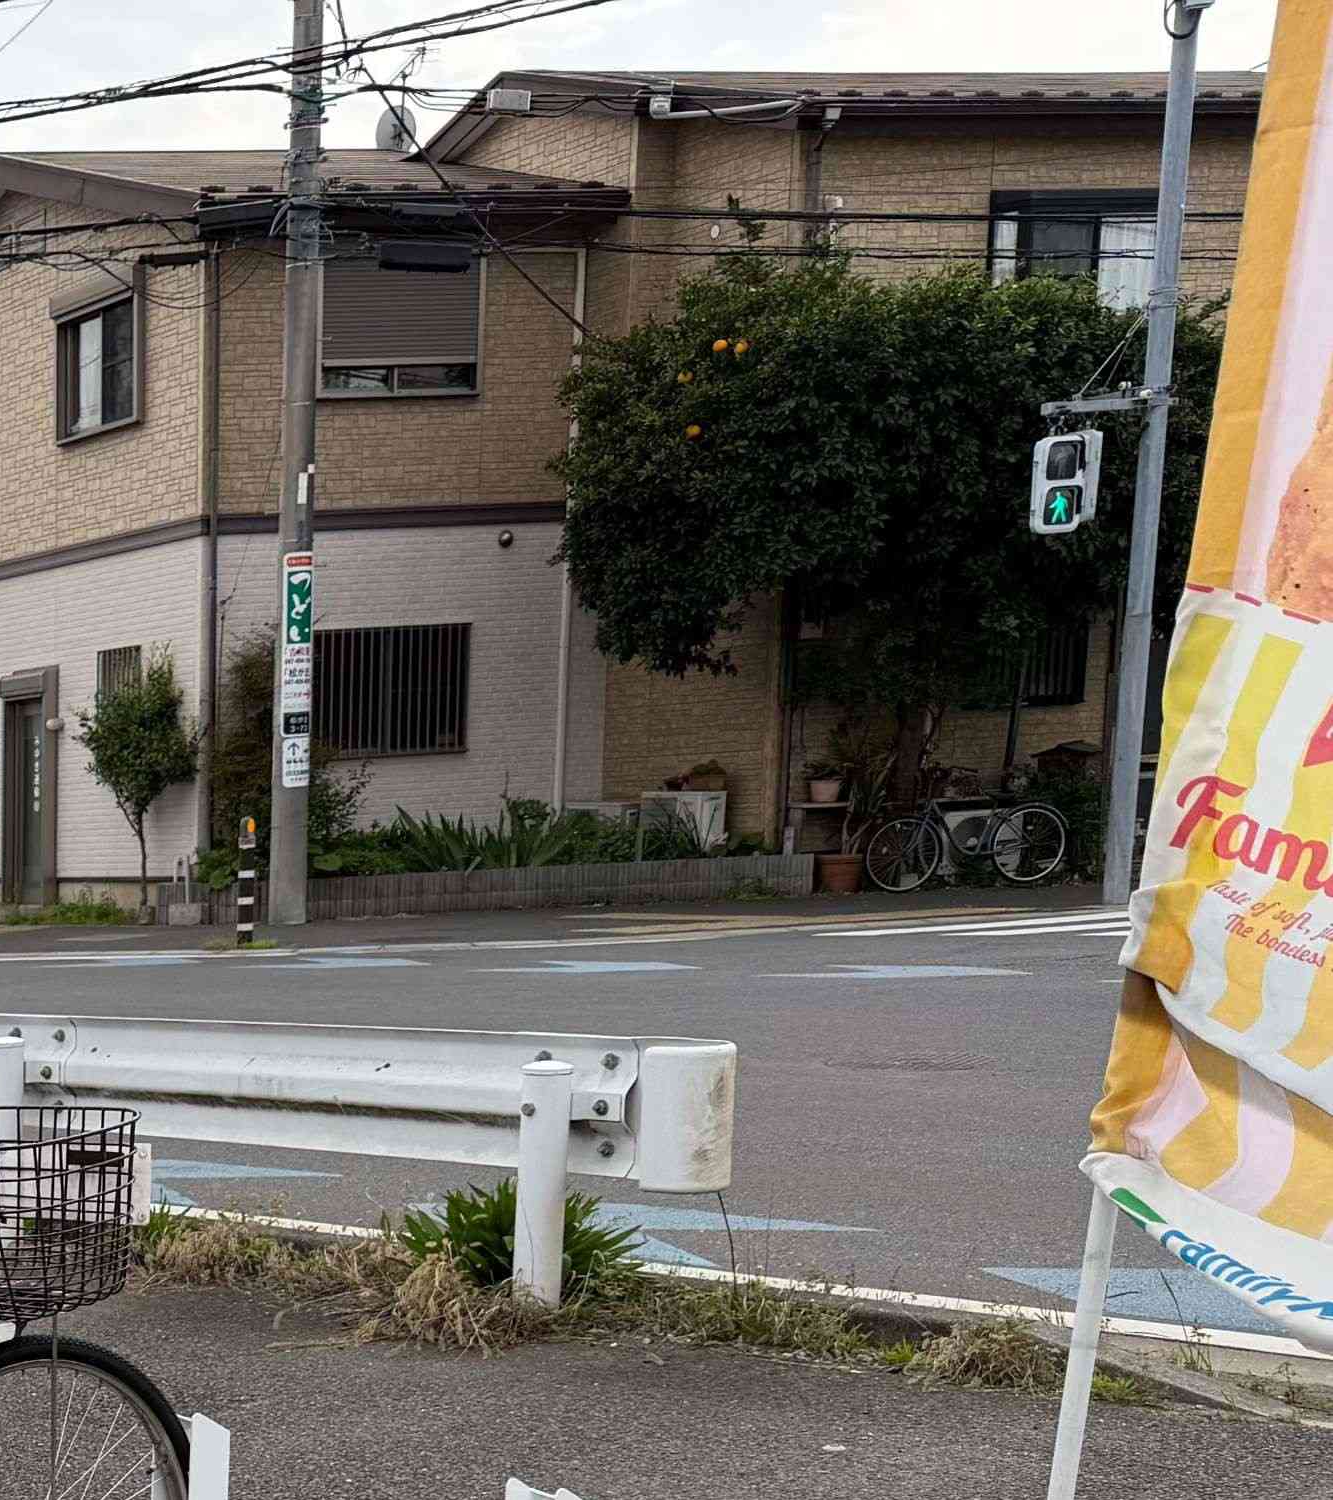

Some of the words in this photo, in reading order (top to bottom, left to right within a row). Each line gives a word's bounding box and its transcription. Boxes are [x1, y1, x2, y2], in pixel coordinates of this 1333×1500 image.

[289, 571, 311, 642] つどい
[1169, 775, 1333, 898] Fam
[1250, 900, 1280, 918] of
[1224, 914, 1255, 938] The
[1255, 929, 1327, 968] boneless
